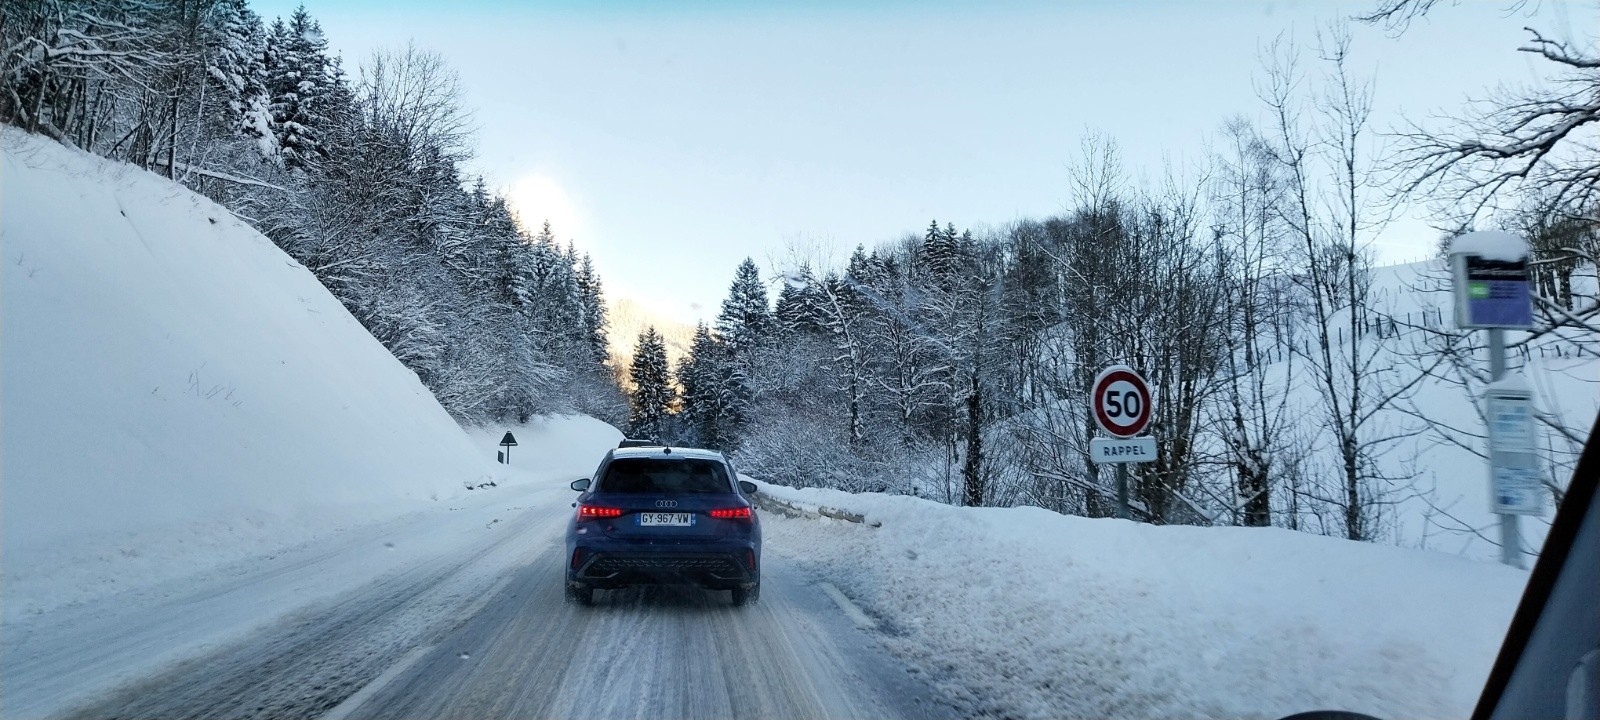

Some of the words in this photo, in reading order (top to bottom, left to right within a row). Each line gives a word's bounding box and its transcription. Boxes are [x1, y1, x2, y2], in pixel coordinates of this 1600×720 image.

[1106, 390, 1140, 418] 50
[1103, 445, 1146, 456] RAPPEL
[642, 513, 689, 524] GY-967-VW
